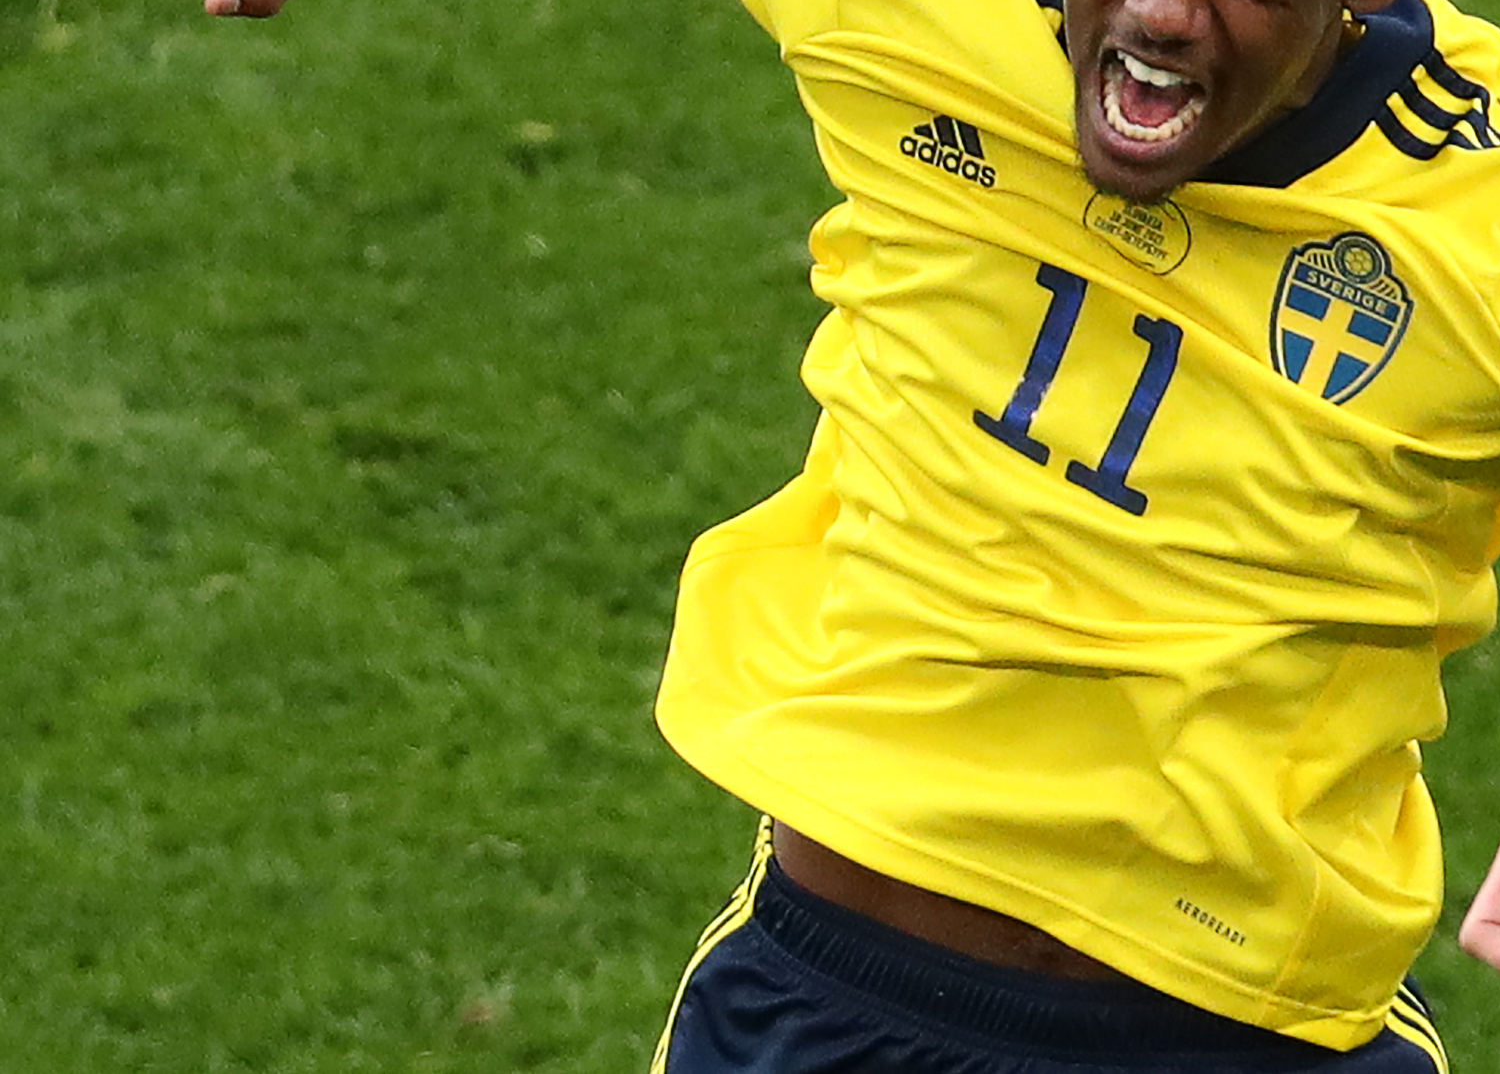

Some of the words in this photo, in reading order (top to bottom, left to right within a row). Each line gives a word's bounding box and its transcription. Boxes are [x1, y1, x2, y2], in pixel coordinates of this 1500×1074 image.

[900, 135, 996, 188] adidas
[1306, 270, 1389, 314] SVERIGE
[973, 262, 1184, 516] 11
[1174, 897, 1246, 947] AEROREADY
